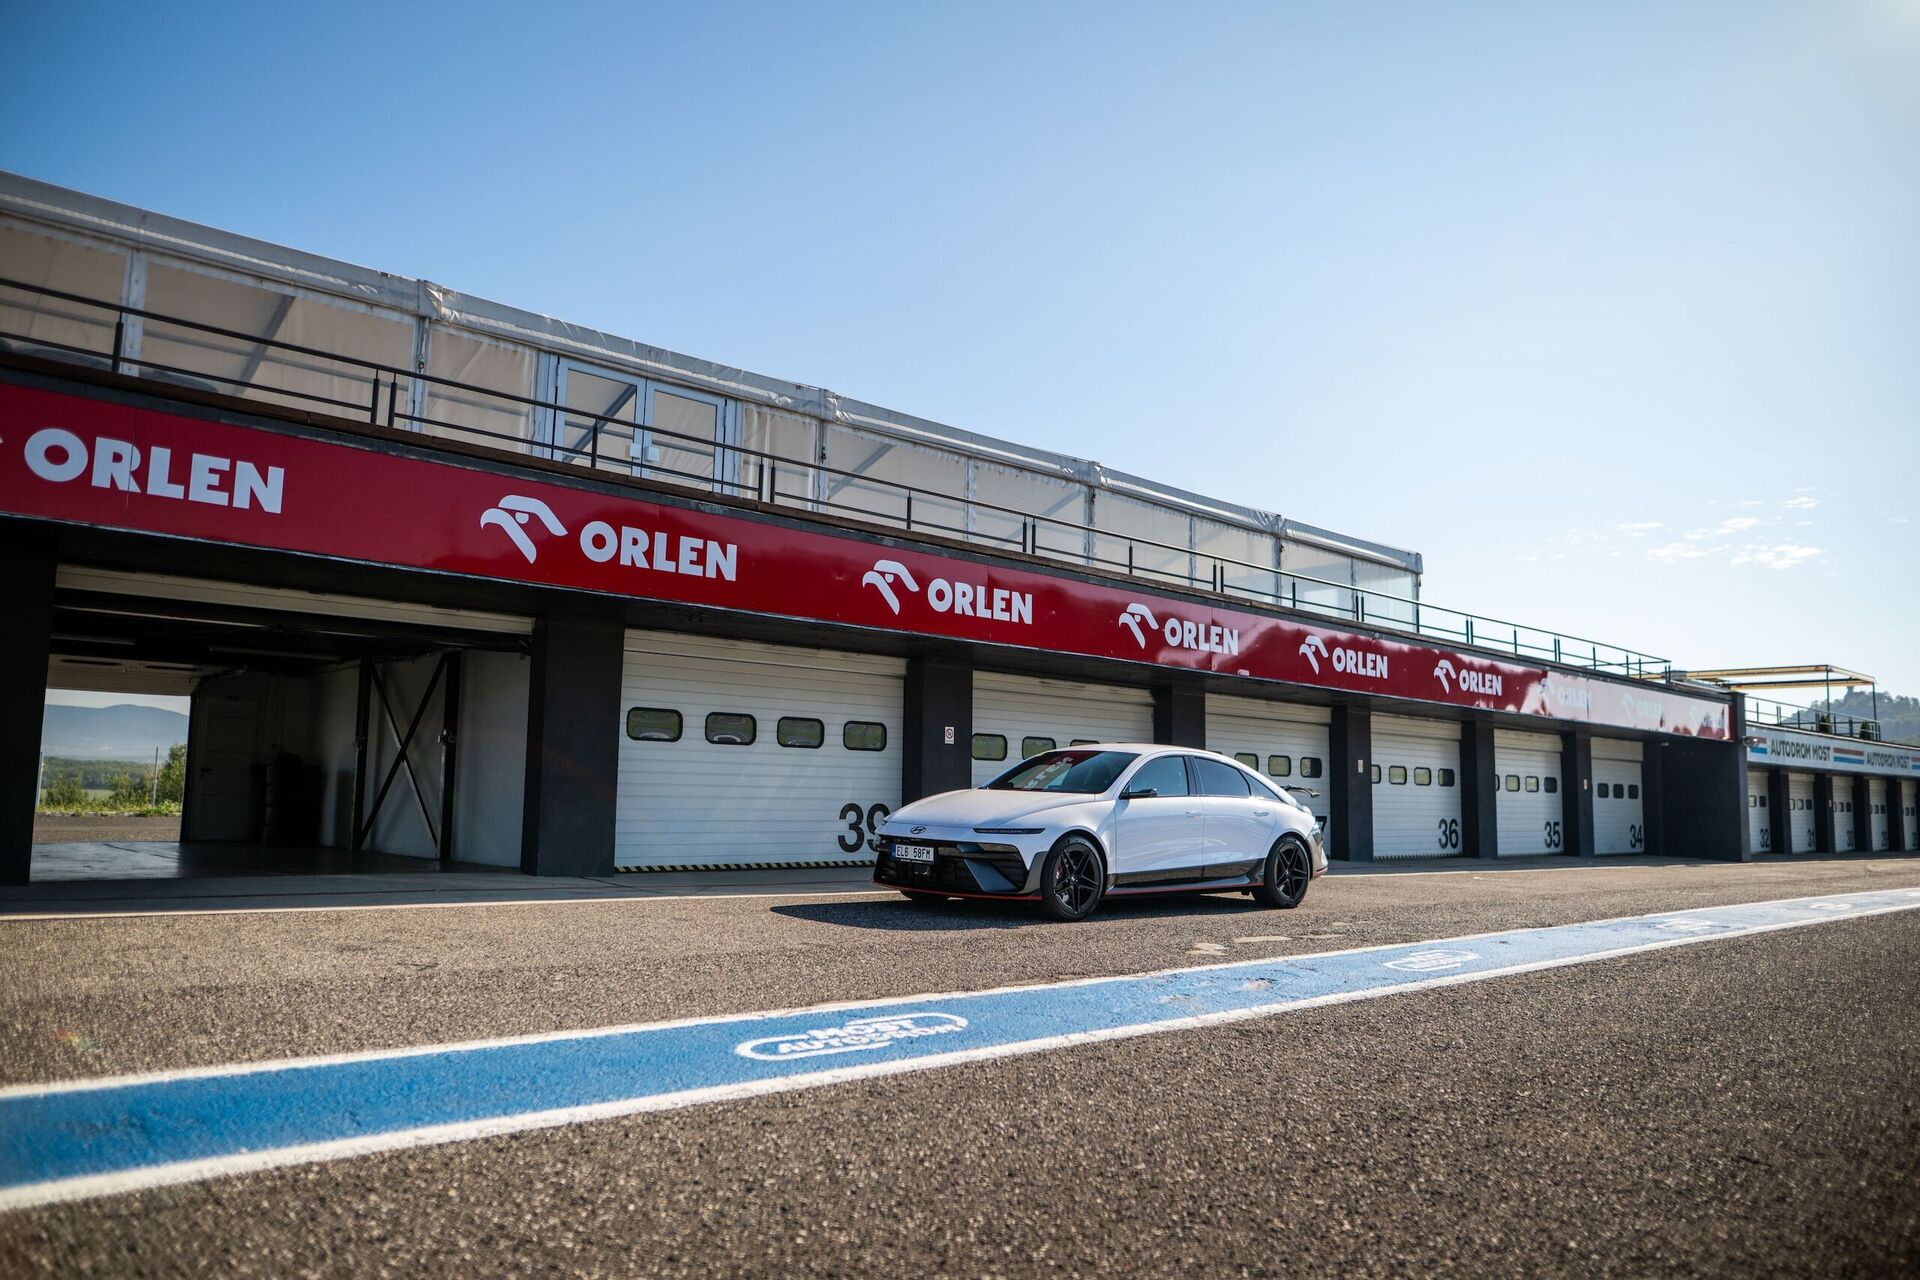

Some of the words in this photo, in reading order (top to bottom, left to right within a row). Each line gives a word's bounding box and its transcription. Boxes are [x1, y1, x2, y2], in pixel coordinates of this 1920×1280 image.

[24, 427, 285, 515] ORLEN
[579, 520, 738, 582] ORLEN
[927, 578, 1033, 624] ORLEN
[1163, 617, 1239, 656] ORLEN
[1331, 646, 1389, 680] ORLEN
[1458, 669, 1503, 697] ORLEN
[1770, 738, 1811, 760] AUTODROM
[1812, 744, 1831, 762] MOST
[1866, 751, 1896, 768] AUTODROM
[1438, 818, 1459, 849] 36
[1544, 821, 1561, 849] 35
[1629, 824, 1643, 849] 34
[1760, 829, 1770, 848] 32
[1807, 829, 1815, 848] 31
[896, 845, 909, 858] EL6
[913, 847, 931, 860] 58FM
[778, 1023, 963, 1054] AUTODROM
[806, 1018, 918, 1040] MOST
